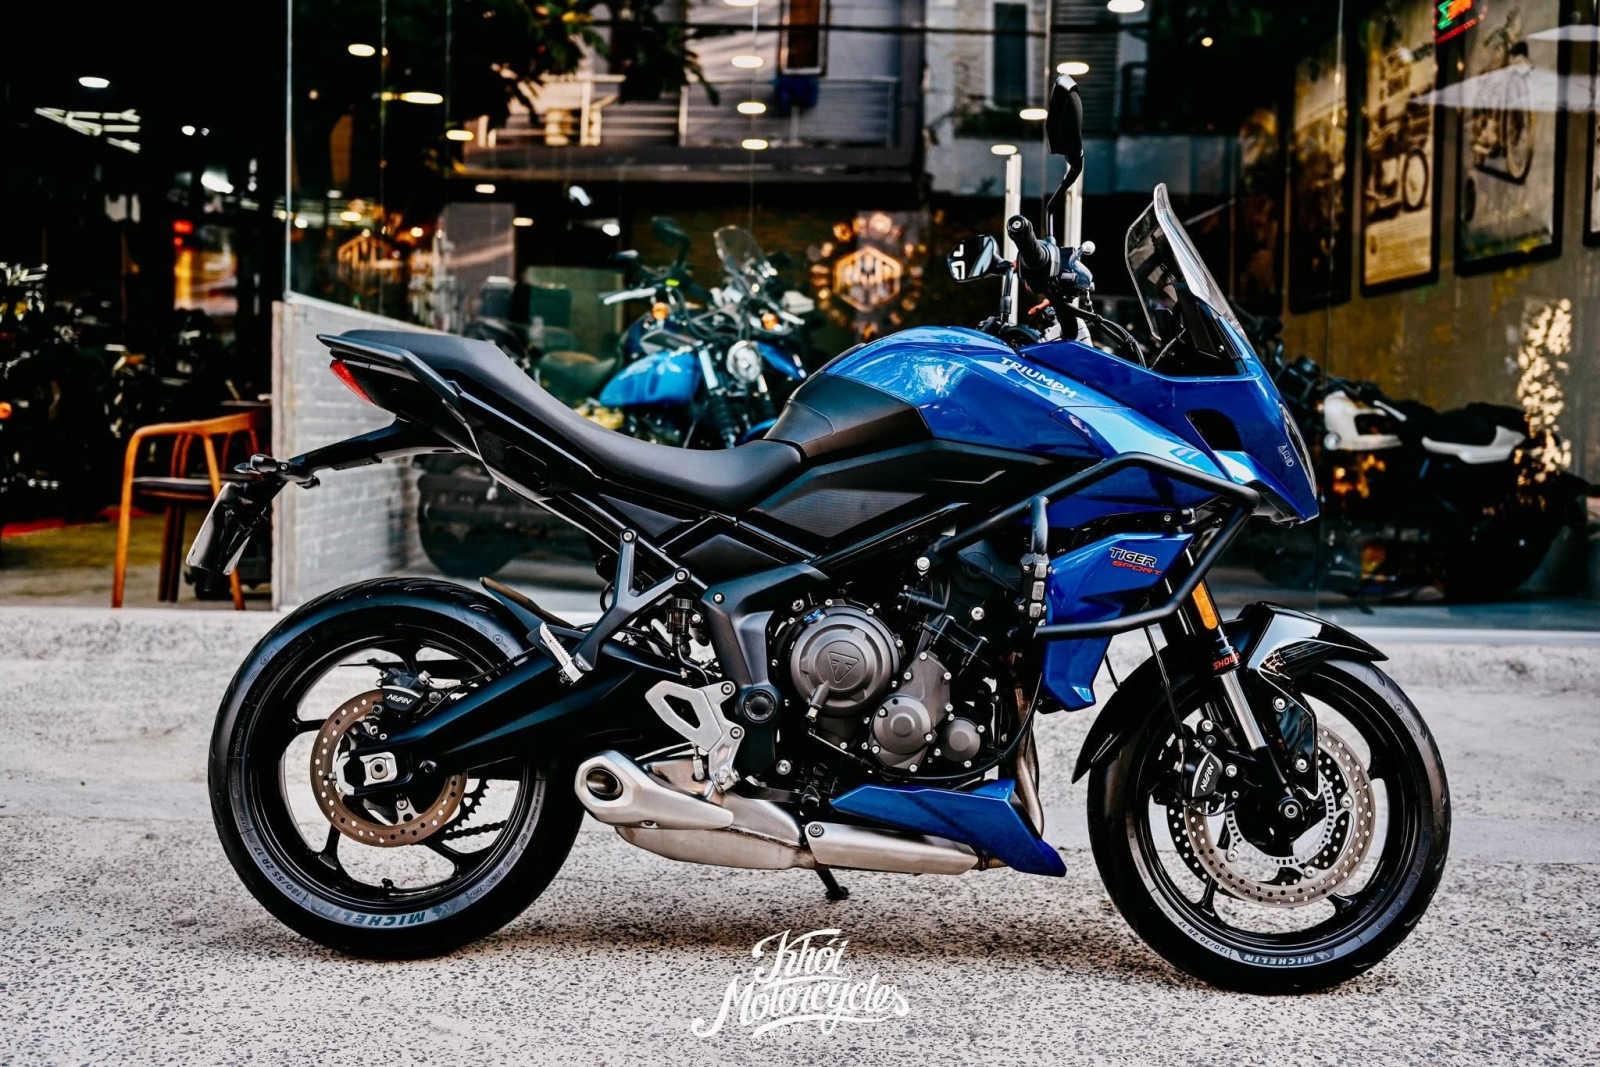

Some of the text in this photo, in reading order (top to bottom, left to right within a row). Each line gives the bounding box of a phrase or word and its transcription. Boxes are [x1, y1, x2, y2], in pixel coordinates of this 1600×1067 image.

[1001, 356, 1077, 398] TRIUMPH
[1109, 546, 1157, 568] TIGER
[1111, 559, 1163, 576] SPORT
[253, 846, 302, 897] 180/55 ZR 17
[1177, 920, 1229, 957] 120/70 ZR 17
[1243, 954, 1314, 966] MICHELIN
